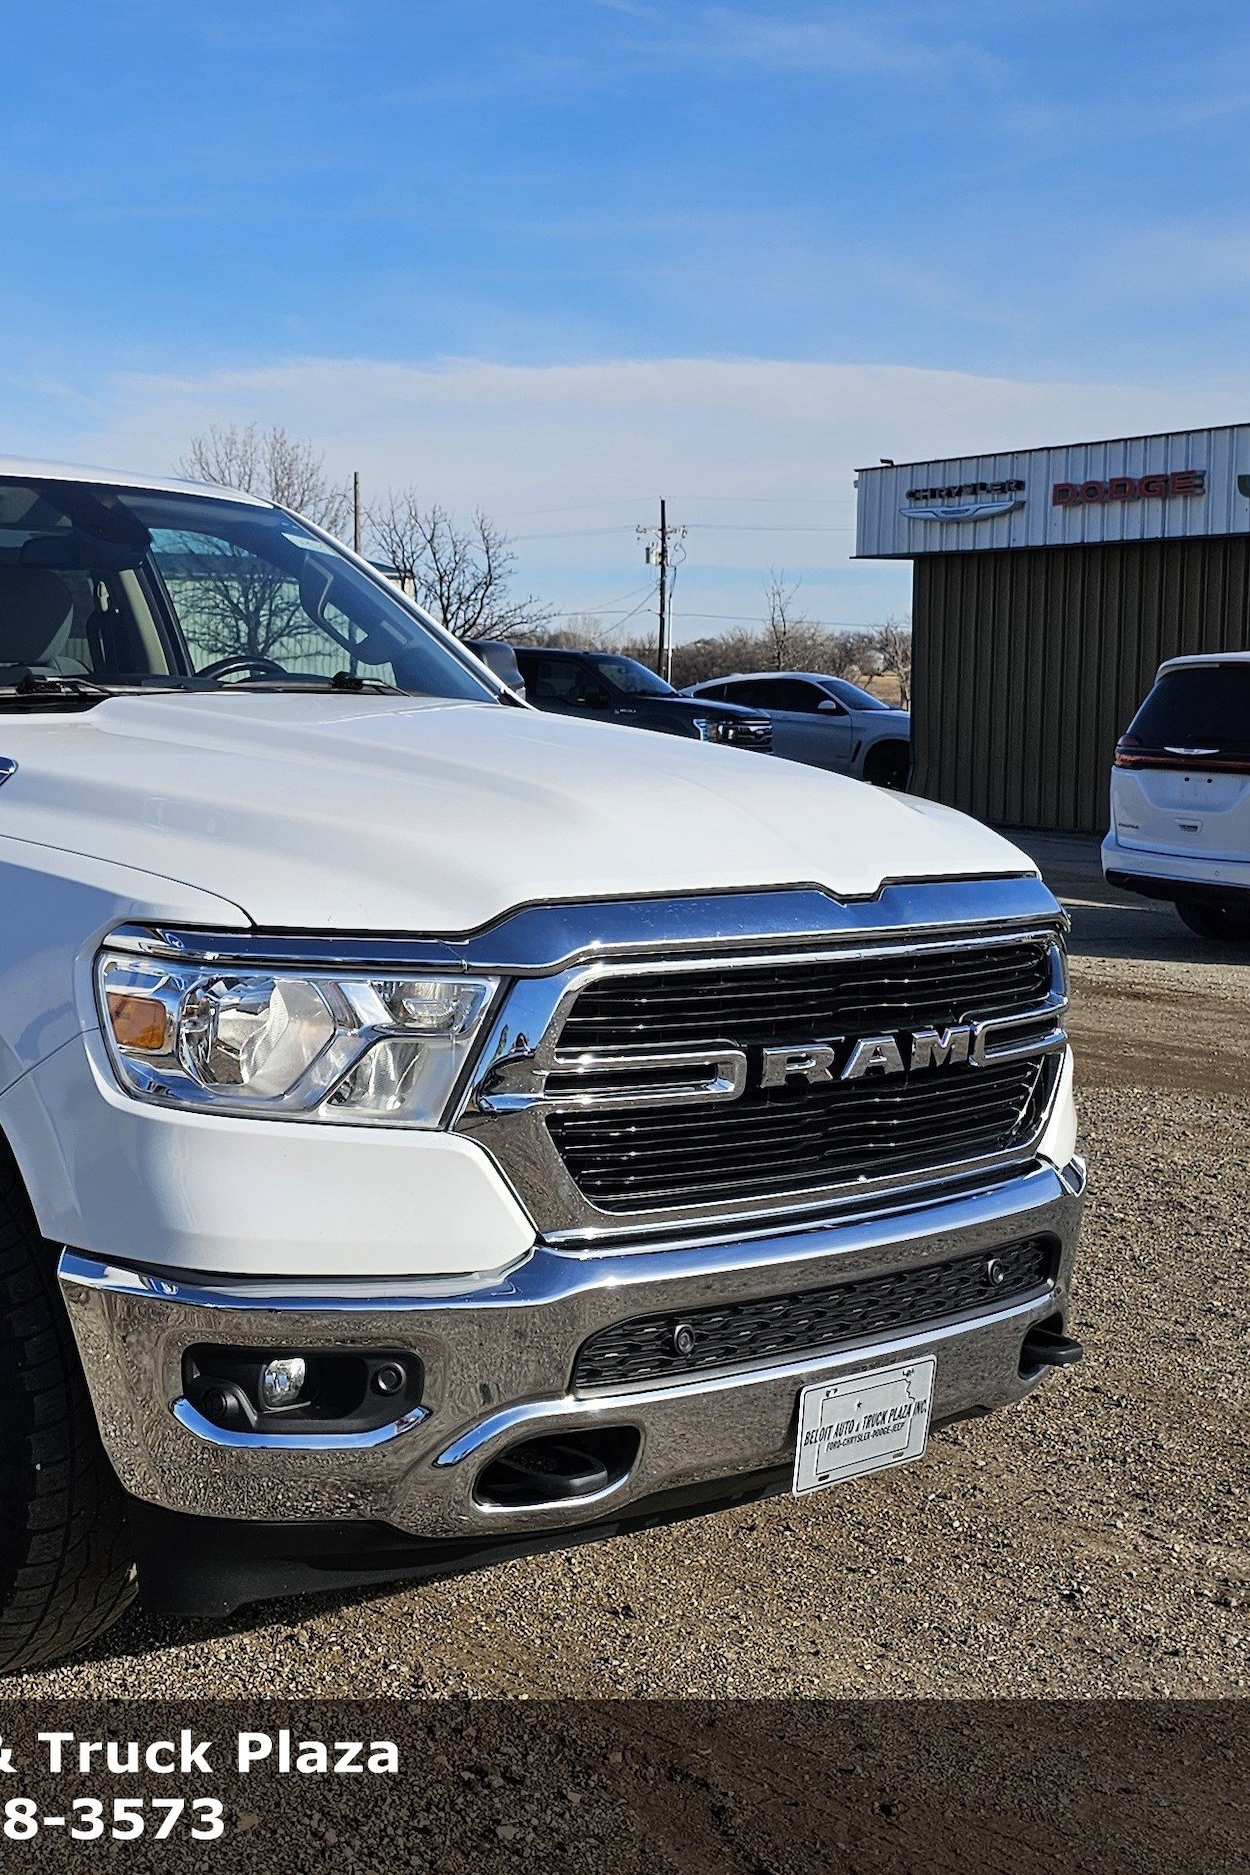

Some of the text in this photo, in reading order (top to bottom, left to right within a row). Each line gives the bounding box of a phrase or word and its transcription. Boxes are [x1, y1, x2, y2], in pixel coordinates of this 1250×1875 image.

[1053, 470, 1206, 507] DODGE
[760, 1024, 971, 1089] RAM
[803, 1424, 834, 1446] BELOIT
[832, 1419, 855, 1439] AUTO
[861, 1409, 888, 1431] TRUCK
[887, 1402, 913, 1424] PLAZA
